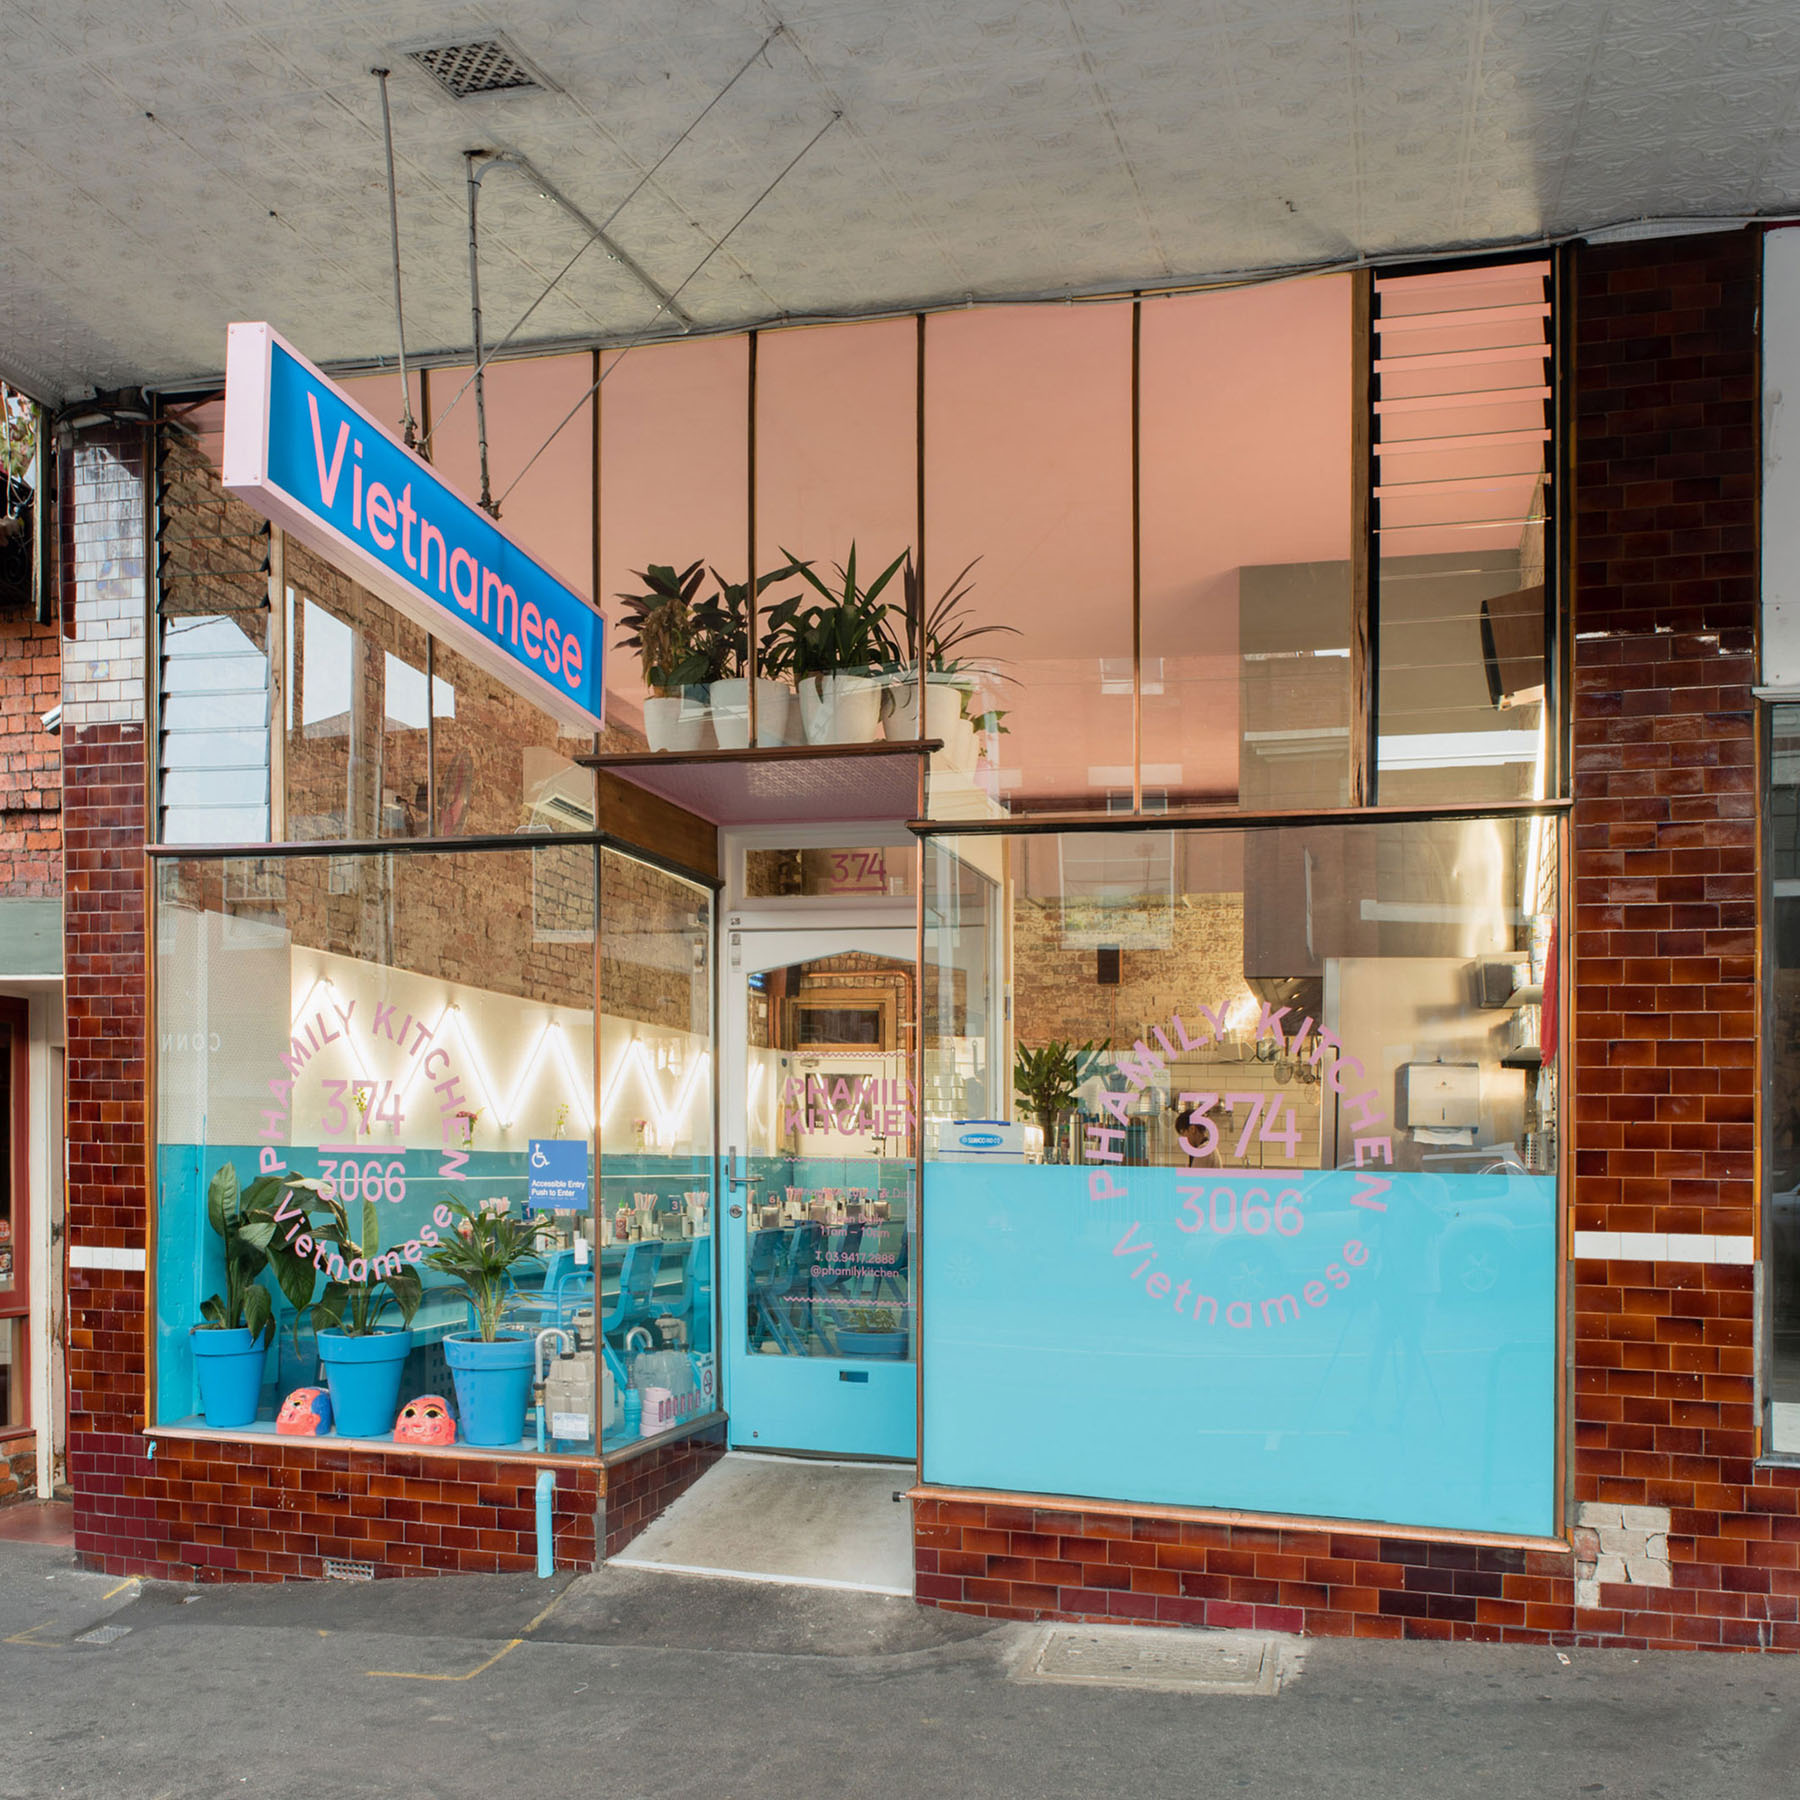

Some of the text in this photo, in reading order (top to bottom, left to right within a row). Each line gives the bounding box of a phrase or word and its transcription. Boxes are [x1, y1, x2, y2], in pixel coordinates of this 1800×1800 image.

[307, 391, 583, 689] Vietnamese
[831, 853, 887, 883] 374
[259, 1000, 470, 1182] PHAMILY KITCHEN
[321, 1079, 405, 1137] 374
[1084, 1000, 1394, 1214] PHAMILY KITCHEN
[784, 1107, 917, 1136] KITCHEN
[1178, 1092, 1302, 1159] 374
[317, 1159, 406, 1204] 3066
[532, 1180, 586, 1191] Accessible Entry
[557, 1189, 576, 1197] Enter
[274, 1190, 453, 1283] Vietnamese
[861, 1226, 891, 1240] 10pm
[1175, 1185, 1304, 1237] 3066
[810, 1265, 900, 1278] @phamilykitchen
[1112, 1221, 1369, 1329] Vietnamese
